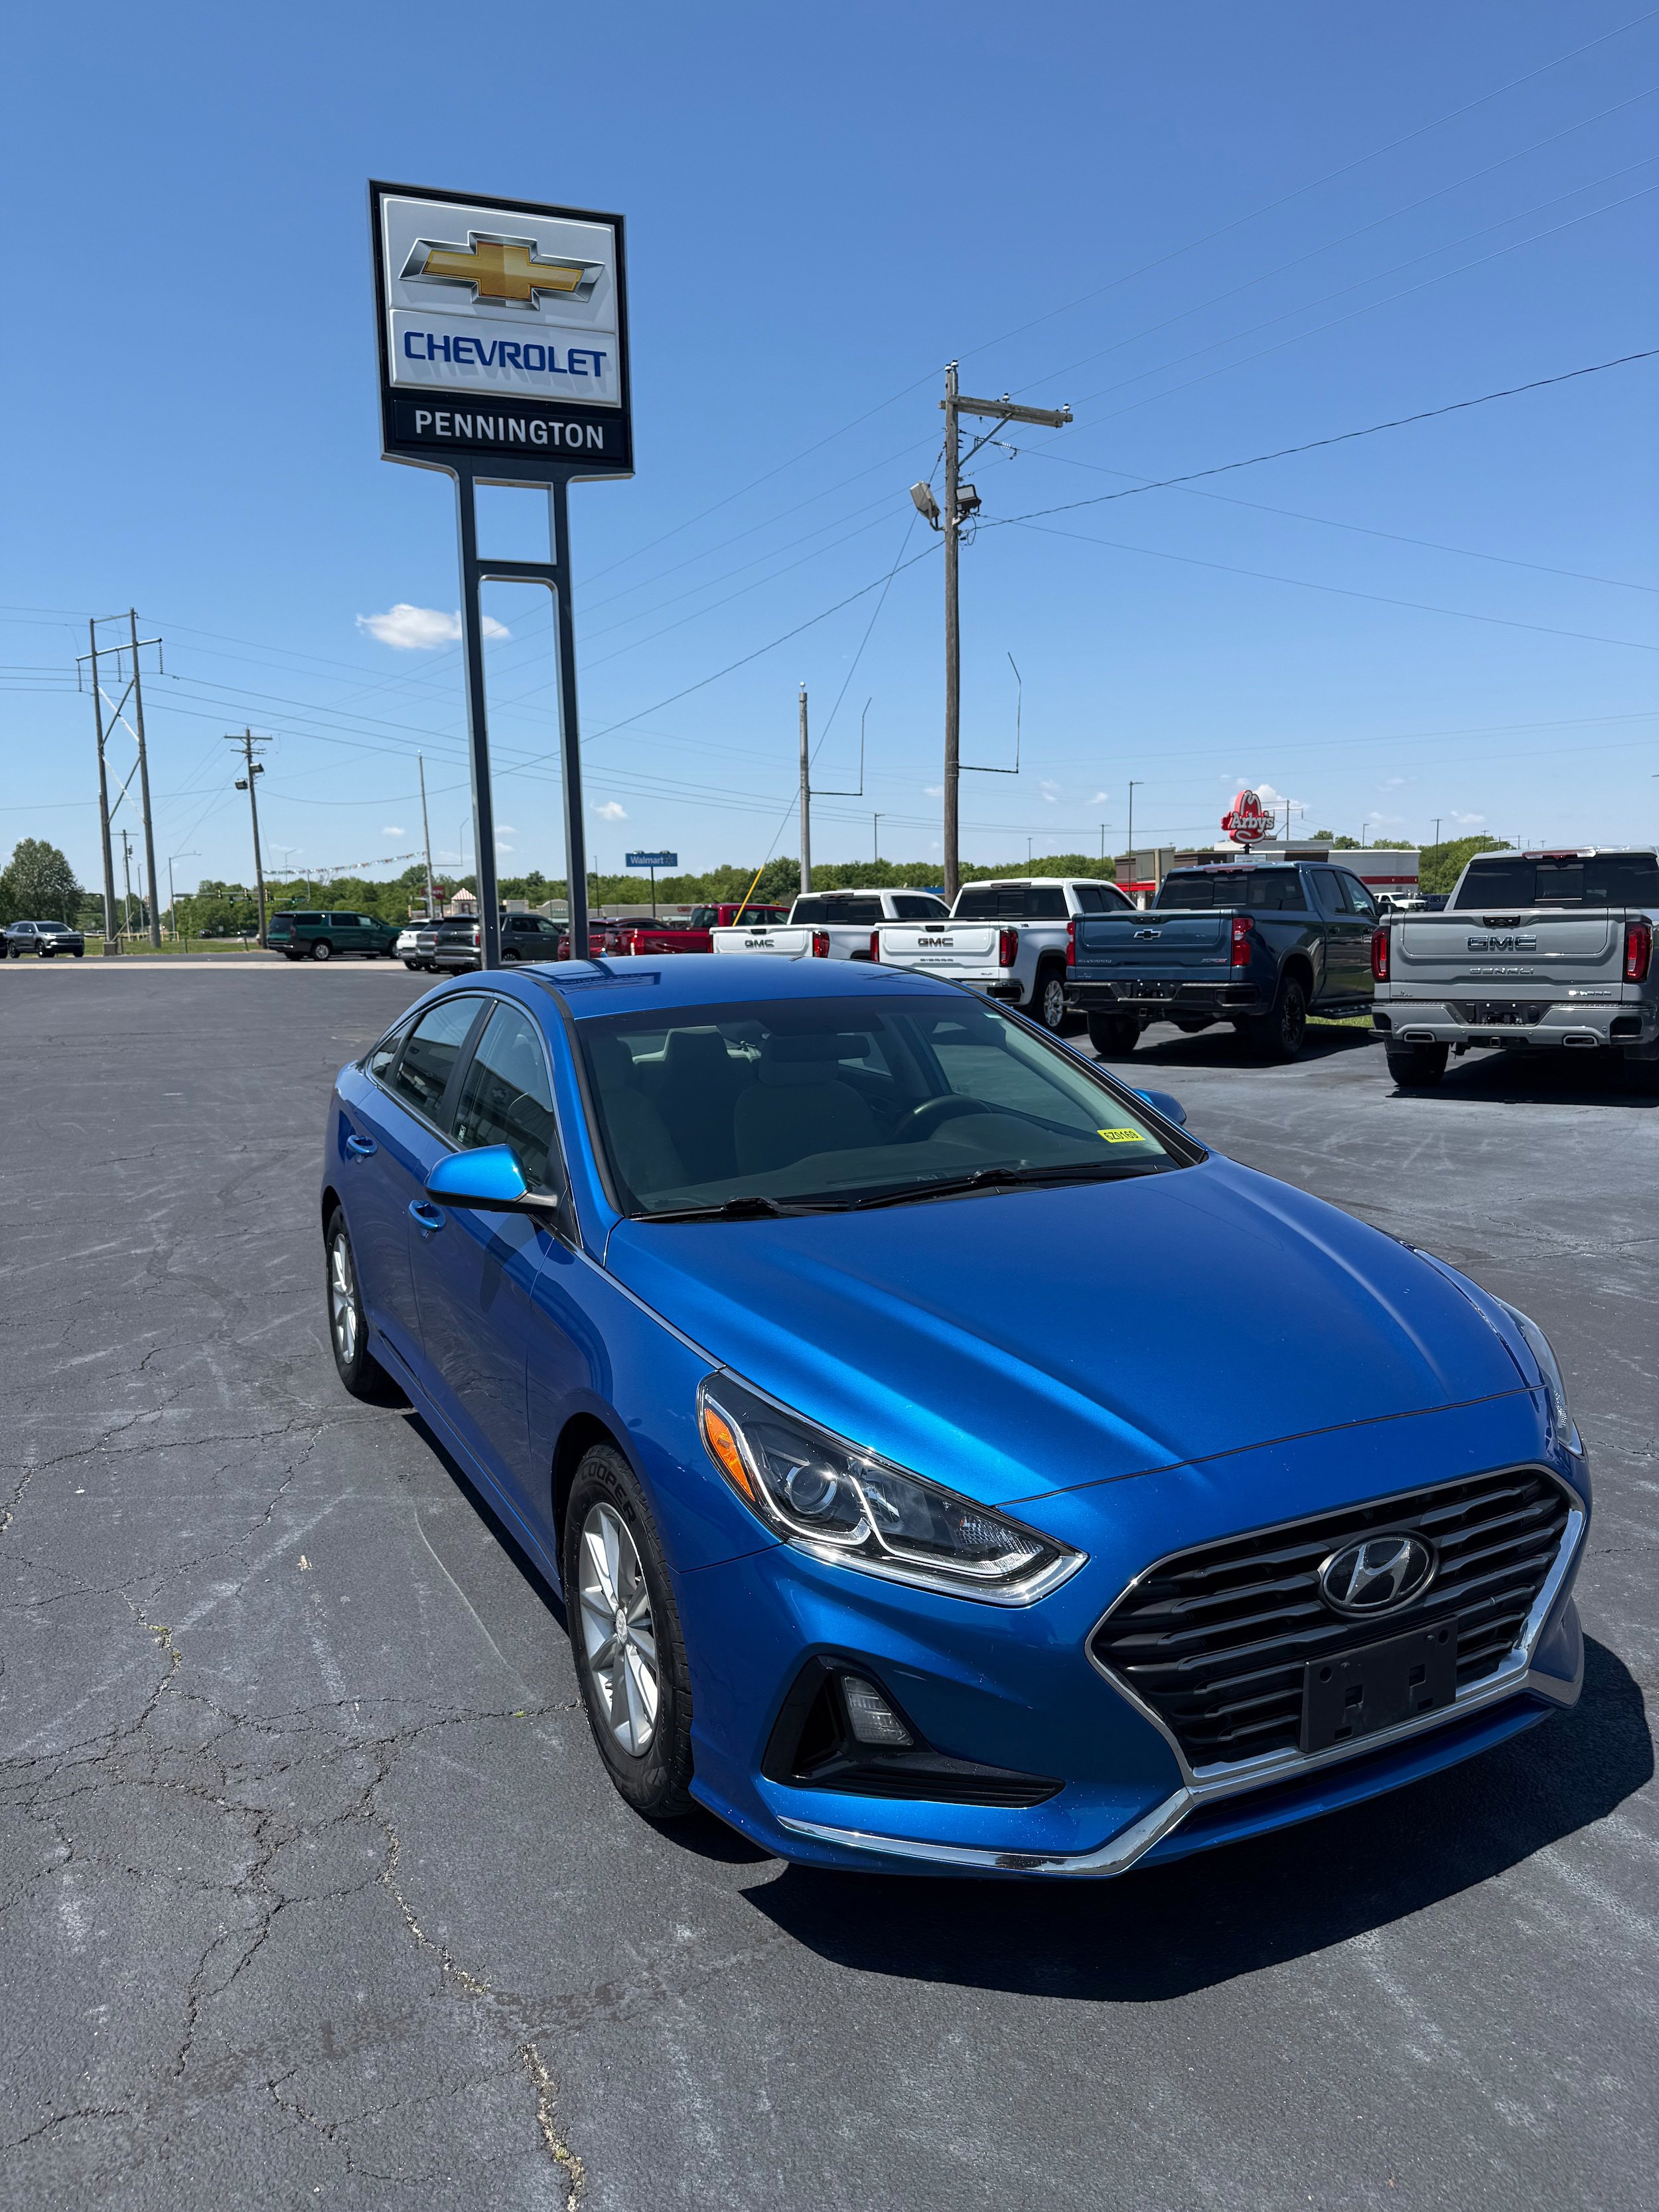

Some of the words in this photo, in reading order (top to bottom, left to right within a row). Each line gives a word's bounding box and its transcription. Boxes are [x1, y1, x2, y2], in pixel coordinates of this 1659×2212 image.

[404, 331, 607, 377] CHEVROLET
[415, 409, 604, 449] PENNINGTON
[1230, 811, 1275, 834] Arby's
[630, 855, 664, 864] Walmart
[745, 939, 774, 948] GMC
[918, 937, 954, 948] GMC
[1467, 934, 1537, 952] GMC
[581, 1461, 636, 1525] COOPER
